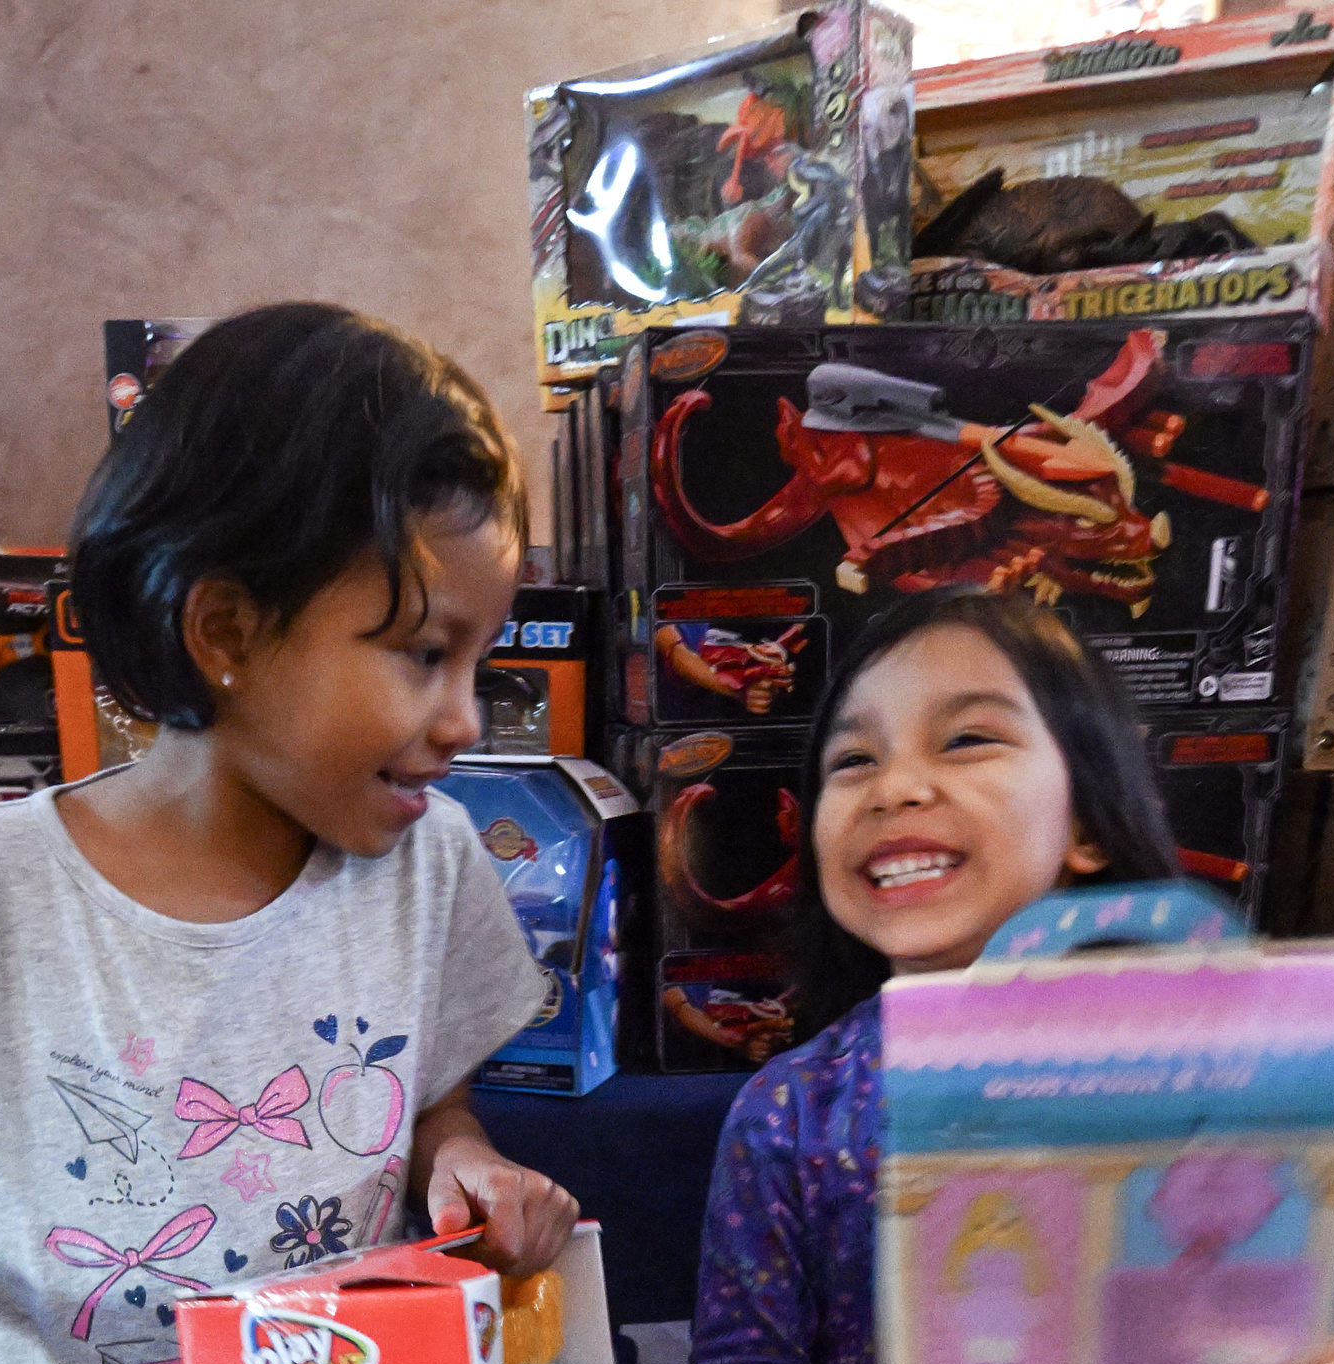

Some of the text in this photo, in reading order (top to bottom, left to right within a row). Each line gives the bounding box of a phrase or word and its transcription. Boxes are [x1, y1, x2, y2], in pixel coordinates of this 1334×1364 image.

[1067, 263, 1294, 321] TRICERATOPS
[520, 621, 573, 648] SET
[50, 1050, 164, 1098] explore your mind
